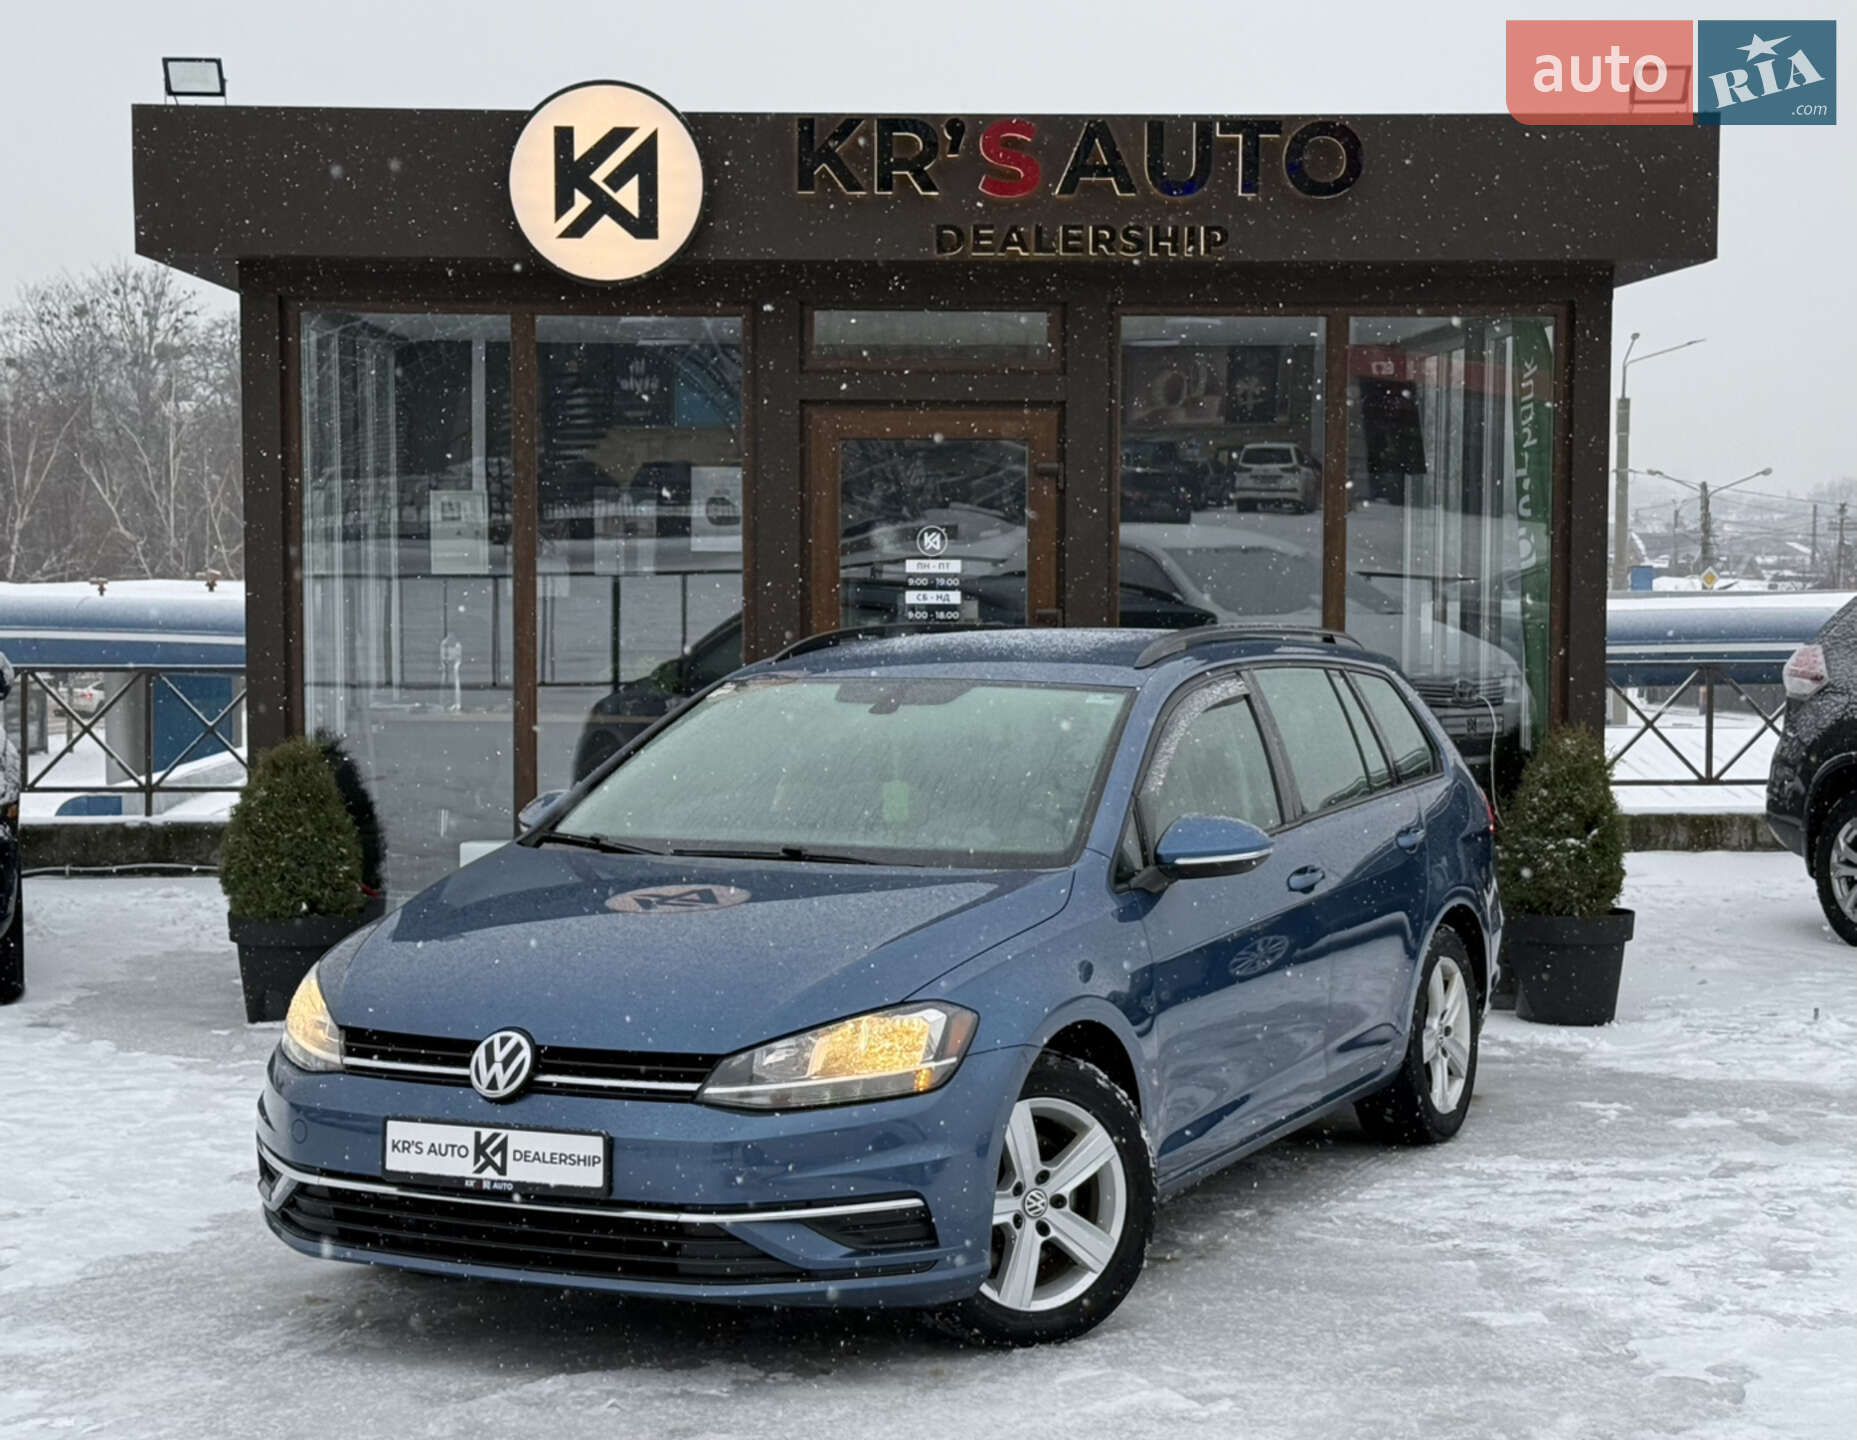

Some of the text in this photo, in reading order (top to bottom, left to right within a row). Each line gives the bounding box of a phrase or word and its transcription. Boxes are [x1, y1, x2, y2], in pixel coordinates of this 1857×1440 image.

[796, 117, 1364, 199] KR'S AUTO
[935, 223, 1229, 256] DEALERSHIP
[391, 1139, 424, 1155] KR'S
[427, 1142, 470, 1159] AUTO
[512, 1149, 602, 1168] DEALERSHIP
